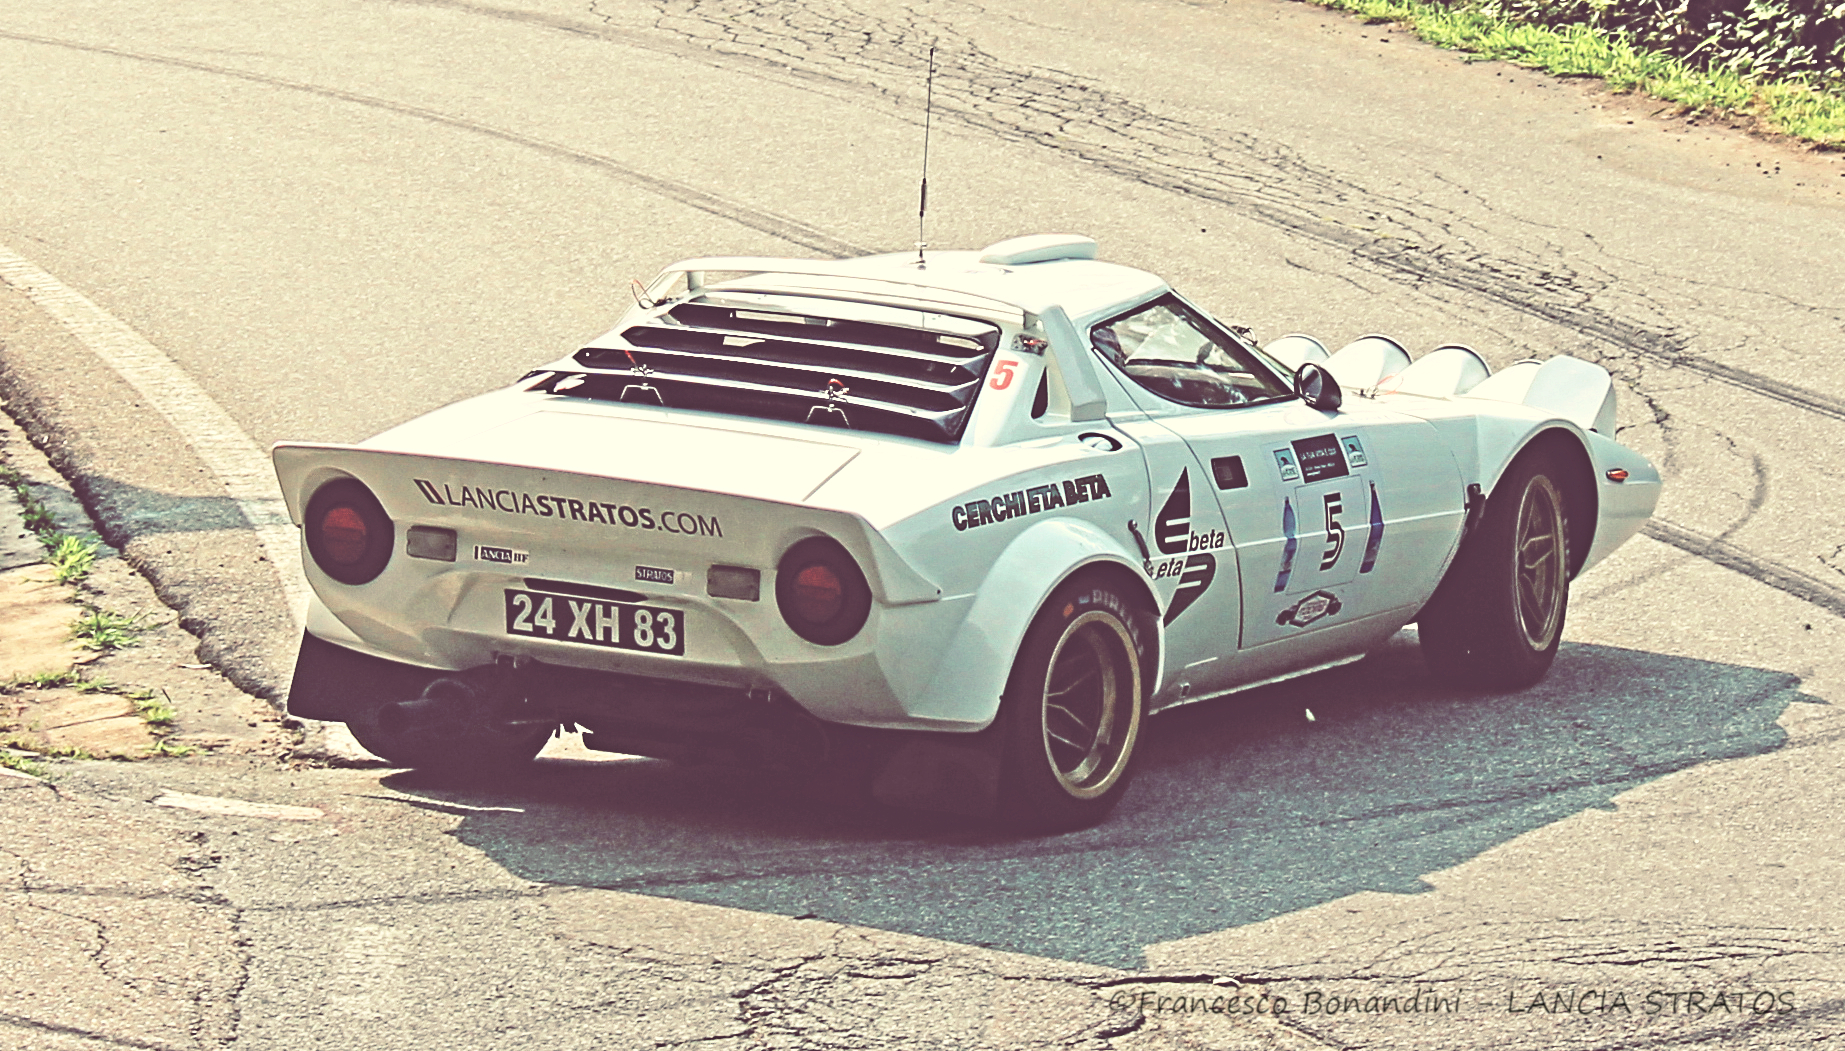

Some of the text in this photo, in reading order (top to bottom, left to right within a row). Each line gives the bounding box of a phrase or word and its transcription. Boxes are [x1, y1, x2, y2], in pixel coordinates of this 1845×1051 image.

[989, 359, 1019, 391] 5
[444, 484, 723, 537] LANCIASTRATOS.COM
[952, 473, 1112, 531] CERCHI ETA BETA
[1189, 529, 1225, 551] beta
[1319, 492, 1345, 572] 5
[636, 567, 674, 583] STRATOS
[1156, 557, 1184, 578] eta
[512, 594, 677, 650] 24 XH 83
